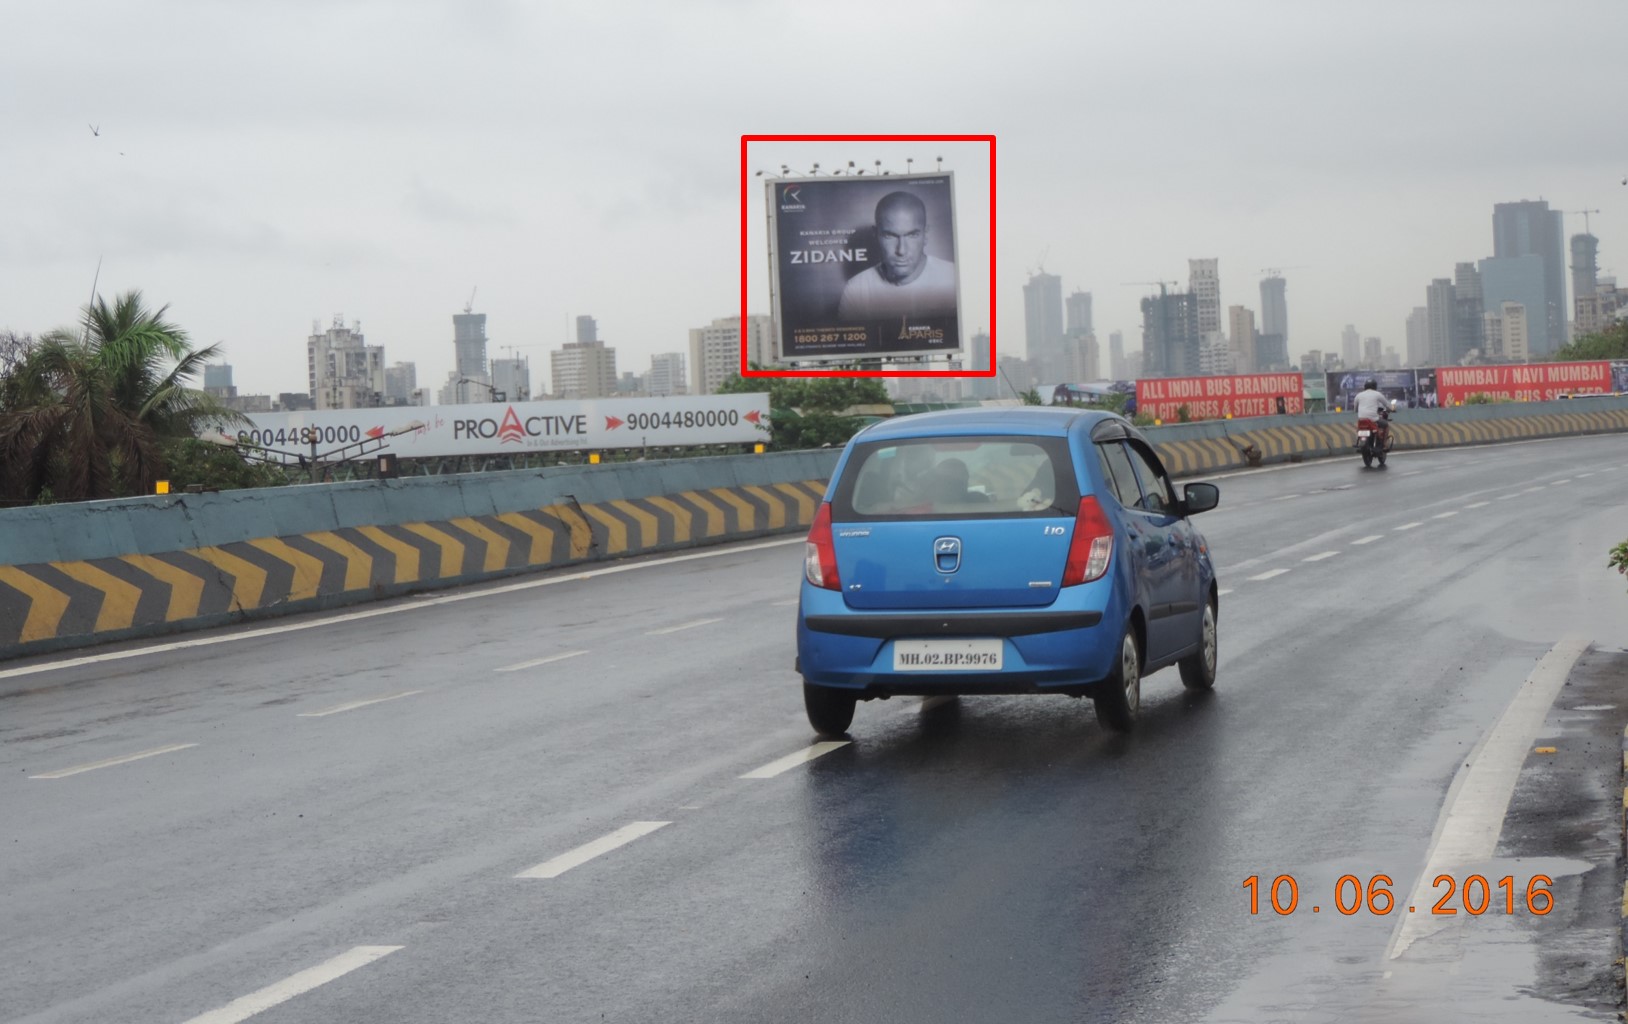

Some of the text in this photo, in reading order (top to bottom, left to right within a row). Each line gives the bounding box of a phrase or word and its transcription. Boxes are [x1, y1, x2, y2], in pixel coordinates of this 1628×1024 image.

[790, 248, 868, 264] ZIDANE
[794, 332, 867, 343] 1800 267 1200
[909, 329, 944, 339] PARIS
[1442, 365, 1604, 386] MUMBAI / NAVI MUMBAI
[1142, 376, 1298, 399] ALL INDIA BUS BRANDING
[1222, 399, 1231, 417] &
[1234, 397, 1265, 416] STATE
[1444, 392, 1455, 408] &
[454, 405, 587, 440] PROACTIVE
[627, 409, 739, 430] 9004480000
[1044, 526, 1065, 535] i10
[900, 652, 997, 665] MH.02.BP.9976
